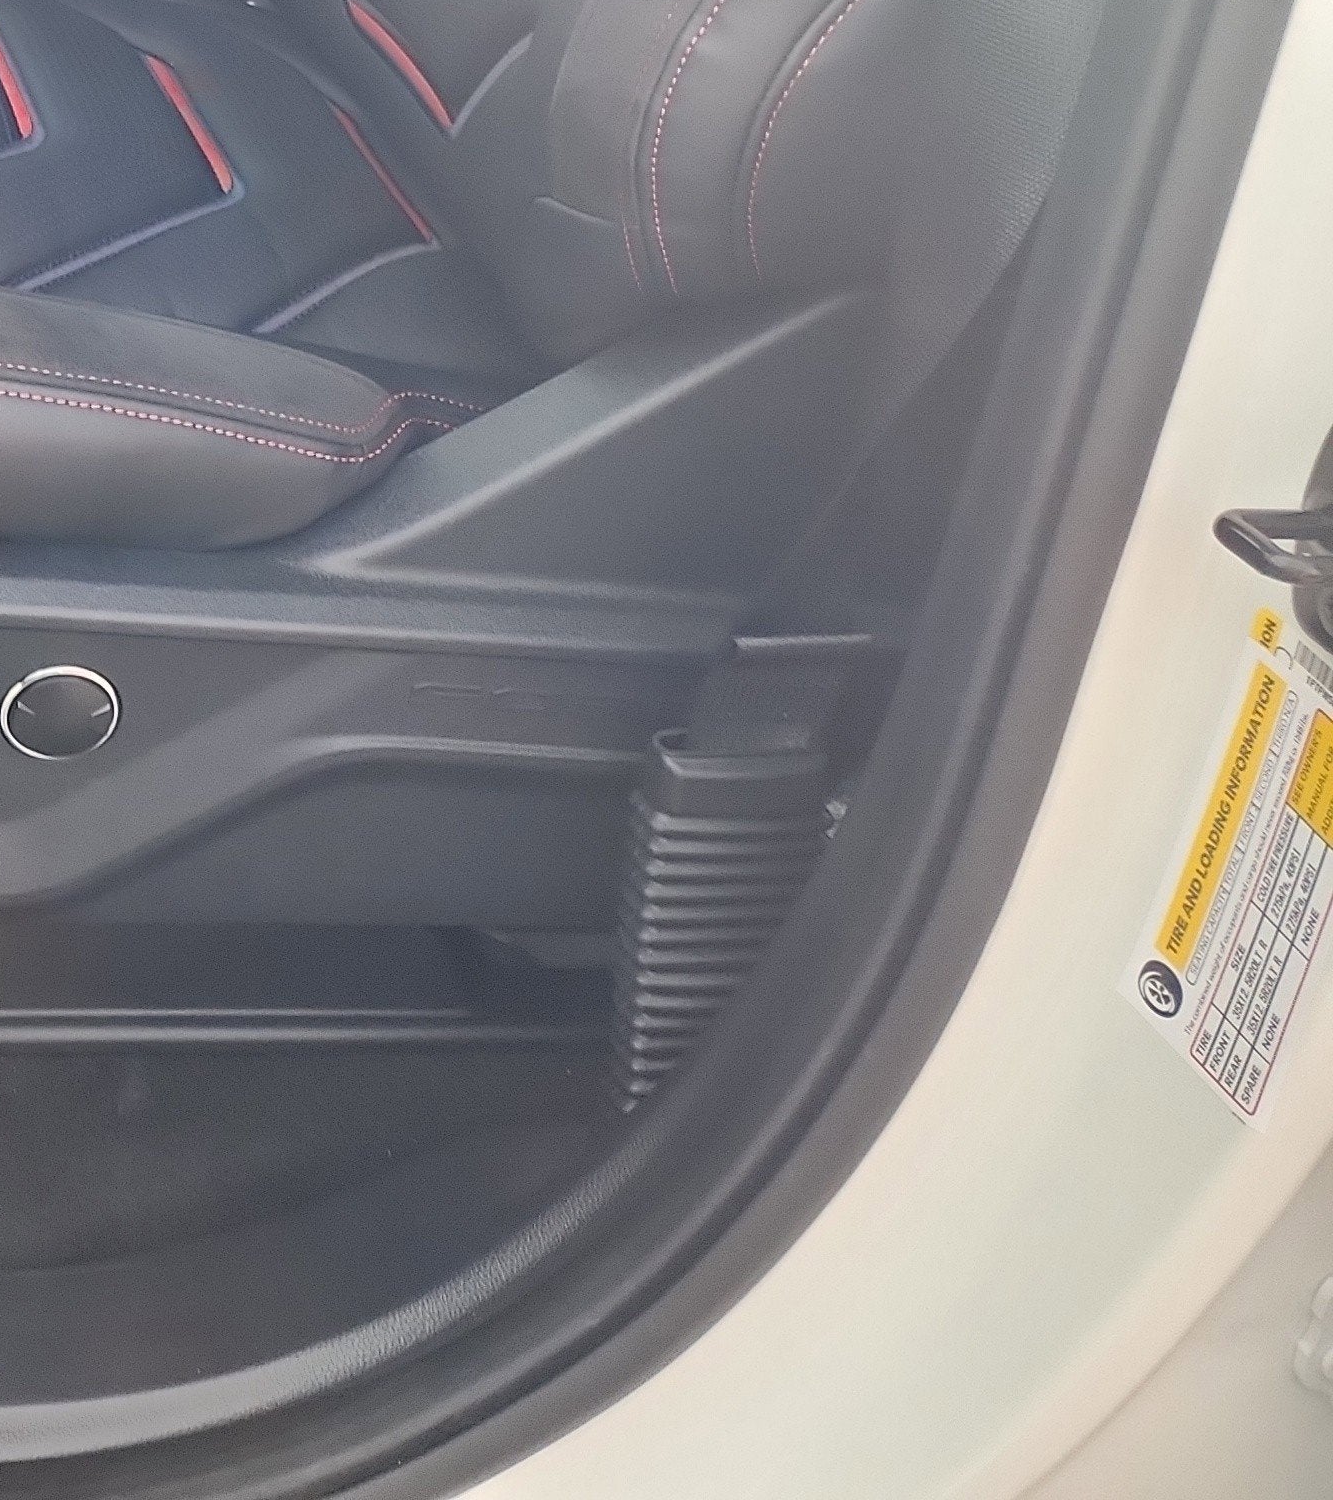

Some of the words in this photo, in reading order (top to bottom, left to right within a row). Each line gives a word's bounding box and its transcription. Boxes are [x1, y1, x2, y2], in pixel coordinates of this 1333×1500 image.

[1306, 771, 1327, 819] MANUAL
[1167, 916, 1188, 956] TIRE
[1182, 877, 1203, 918] AND
[1196, 799, 1232, 879] LOADING
[1225, 674, 1275, 801] INFORMATION
[1257, 875, 1272, 903] COLD
[1273, 812, 1294, 859] PRESSURE
[1301, 908, 1319, 946] NONE
[1231, 944, 1246, 972] SIZE
[1197, 1030, 1212, 1058] TIRE
[1262, 1013, 1280, 1050] NONE
[1210, 1031, 1231, 1072] FRONT
[1225, 1055, 1242, 1088] REAR
[1242, 1065, 1261, 1105] SPARE
